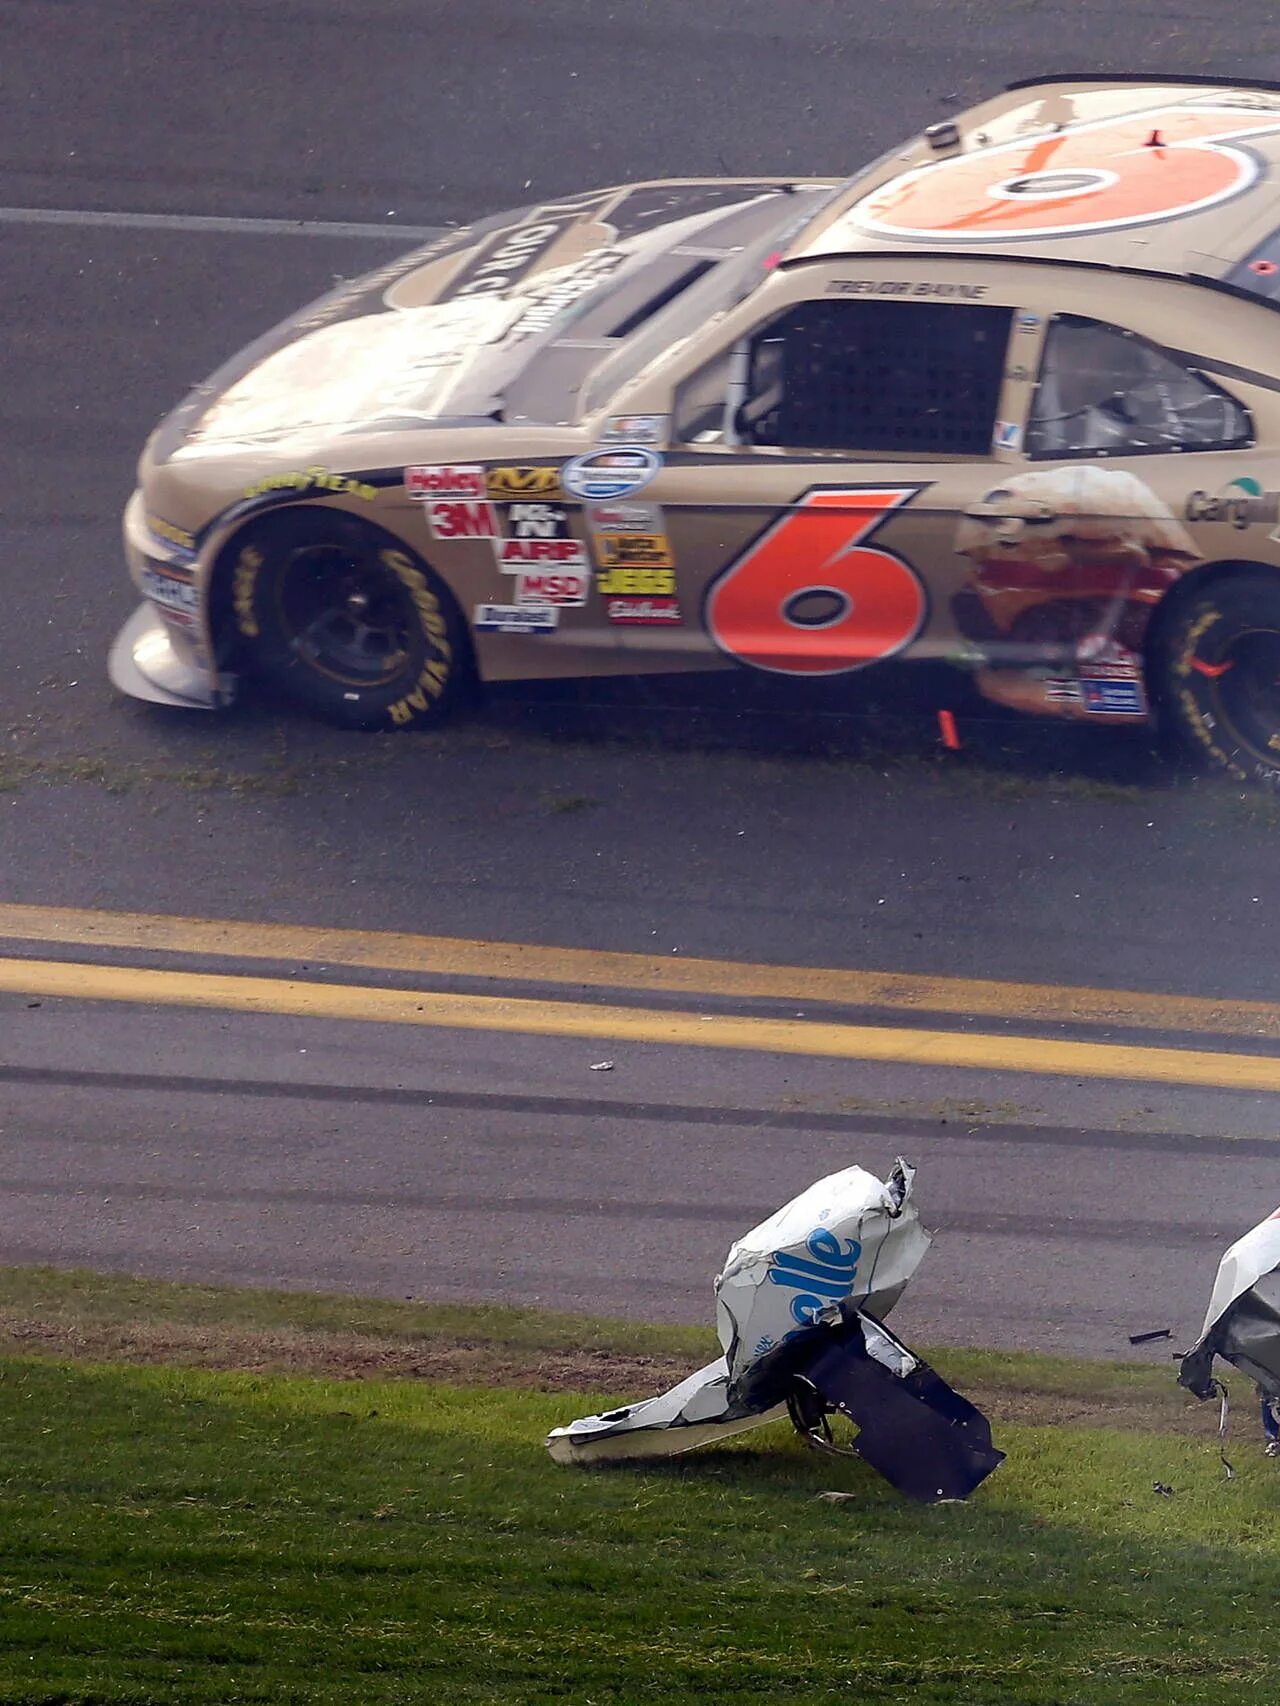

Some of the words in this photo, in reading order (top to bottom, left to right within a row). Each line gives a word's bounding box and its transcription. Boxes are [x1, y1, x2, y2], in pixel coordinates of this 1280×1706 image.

[823, 278, 911, 297] TREVOR
[913, 281, 988, 300] BAYNE
[431, 502, 495, 537] 3M
[502, 542, 580, 560] ARP
[522, 576, 581, 596] MSD
[704, 481, 937, 677] 6
